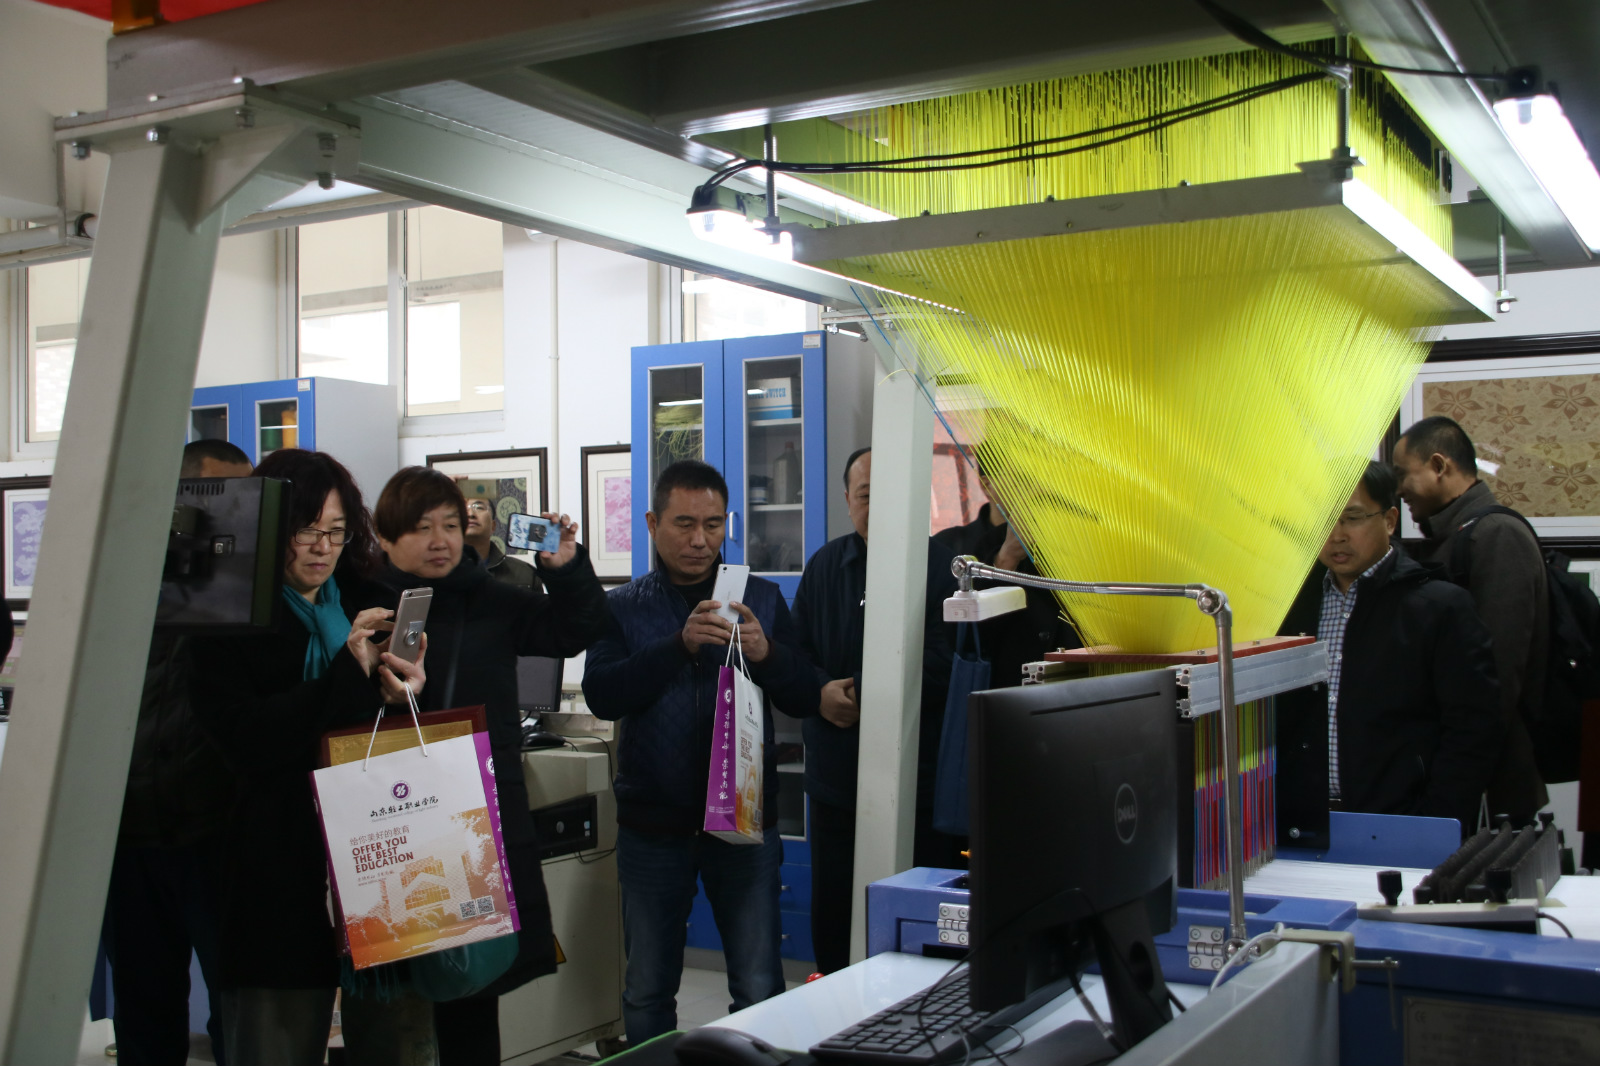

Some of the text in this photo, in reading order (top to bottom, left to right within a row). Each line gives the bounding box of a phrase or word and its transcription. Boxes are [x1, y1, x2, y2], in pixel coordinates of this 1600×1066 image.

[1117, 804, 1136, 823] DELL
[349, 824, 410, 847] 给你美好的教育
[352, 835, 407, 856] OFFER YOU
[353, 846, 398, 865] THE BEST
[355, 851, 414, 874] EDUCATION
